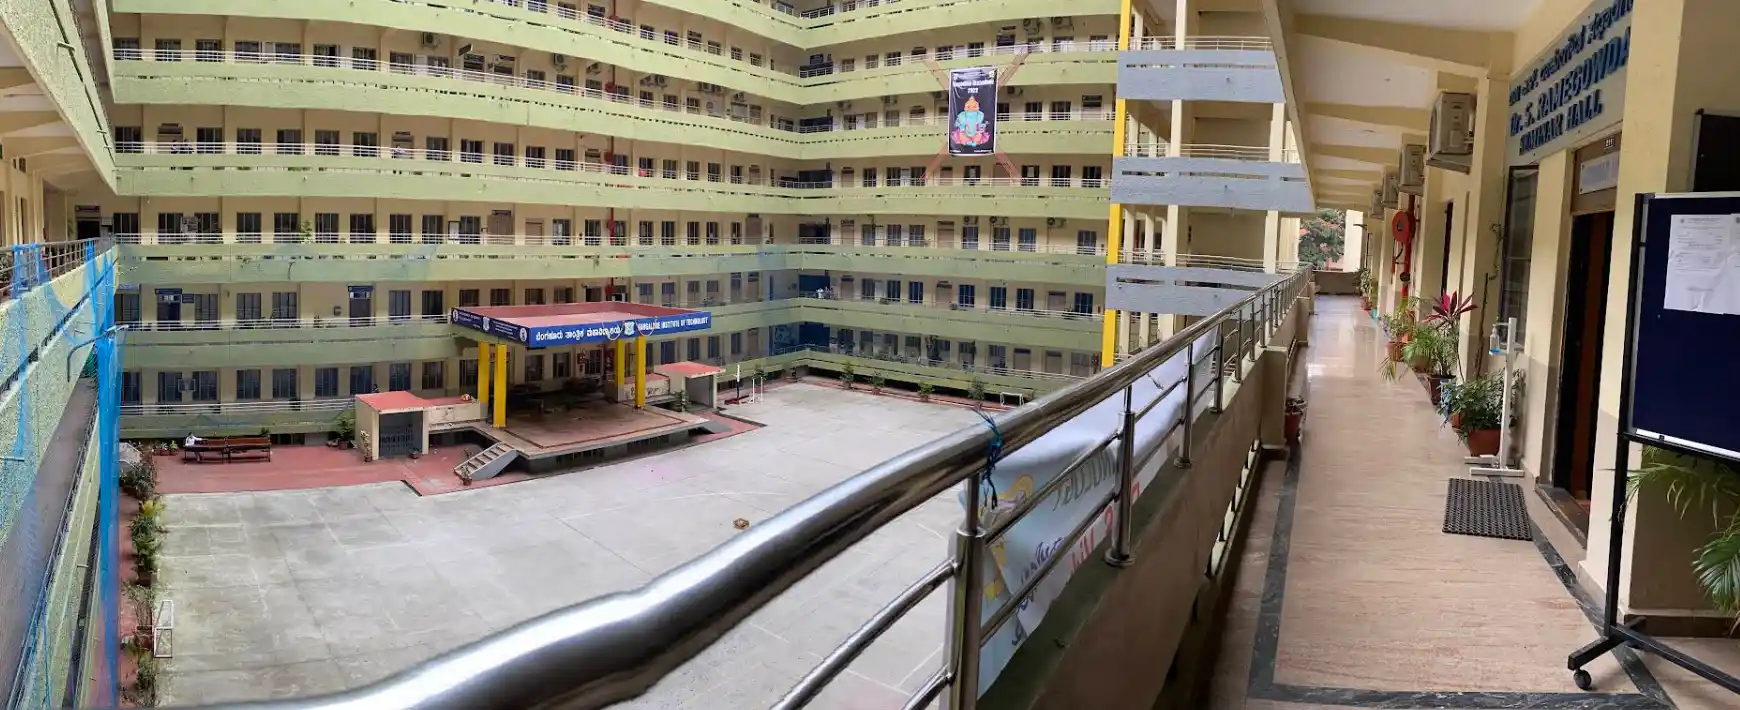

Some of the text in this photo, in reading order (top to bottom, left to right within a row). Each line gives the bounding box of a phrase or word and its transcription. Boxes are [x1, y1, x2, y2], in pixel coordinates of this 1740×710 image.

[1510, 26, 1631, 136] Dr. S. RAMEGOWDA
[1519, 88, 1603, 156] SEMINAR HALL
[661, 319, 680, 329] INSTITUTE
[686, 316, 709, 326] TECHNOLOGY
